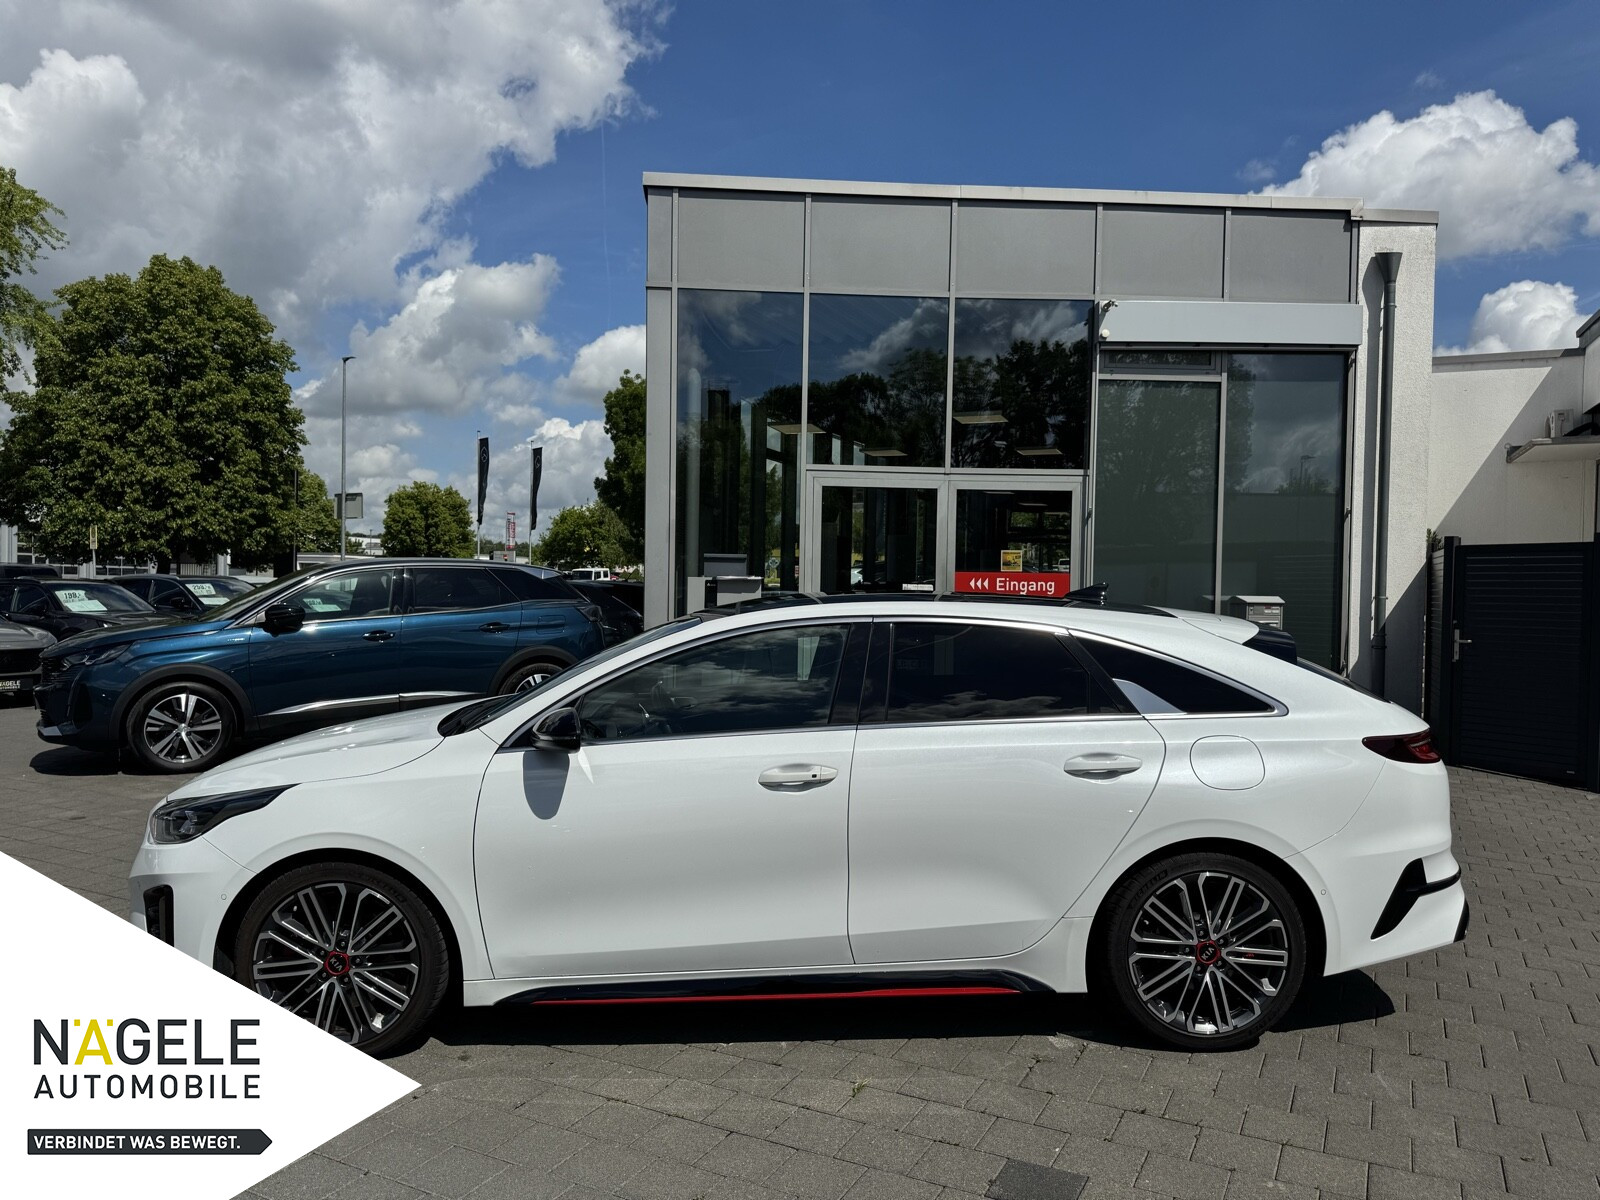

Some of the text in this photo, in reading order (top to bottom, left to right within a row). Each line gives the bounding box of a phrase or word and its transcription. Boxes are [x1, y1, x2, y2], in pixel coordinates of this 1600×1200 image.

[996, 577, 1055, 595] Eingang
[1201, 947, 1215, 960] KIA
[329, 956, 343, 972] KIA
